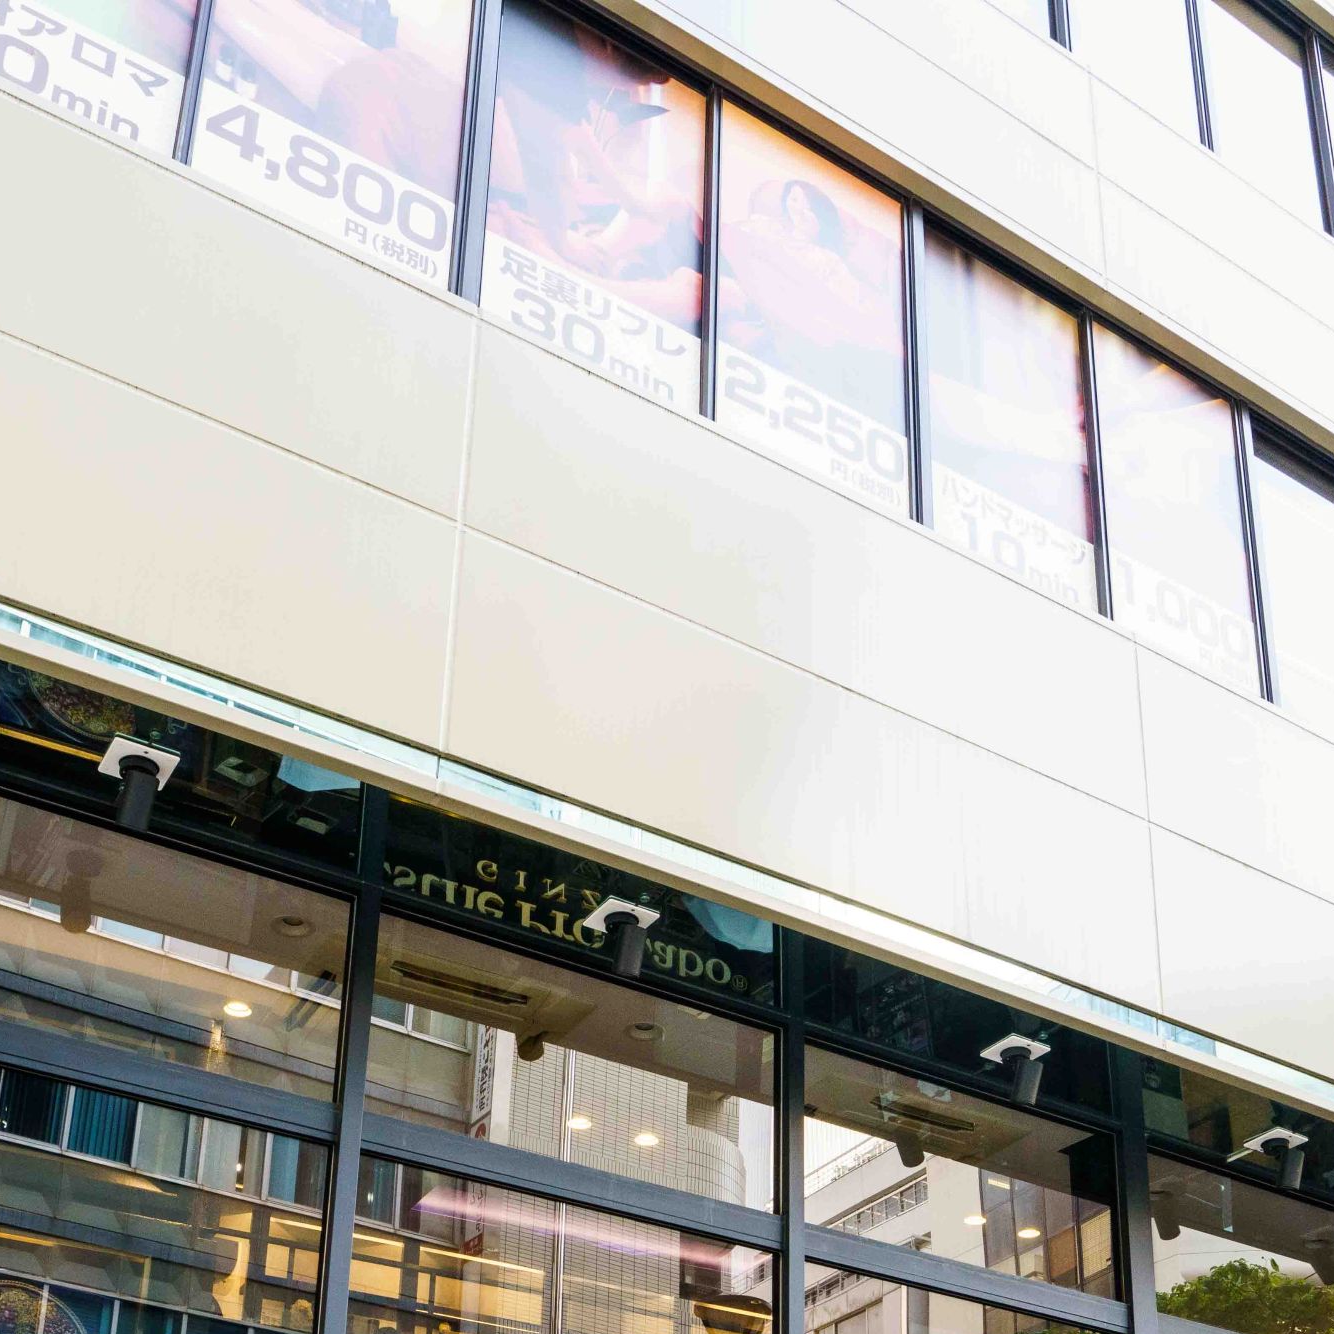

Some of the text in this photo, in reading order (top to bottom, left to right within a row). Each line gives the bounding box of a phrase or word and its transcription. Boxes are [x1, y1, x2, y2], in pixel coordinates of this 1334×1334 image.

[205, 103, 448, 254] 4,800
[499, 251, 687, 358] 足裏リフレ
[724, 355, 907, 485] 2,250
